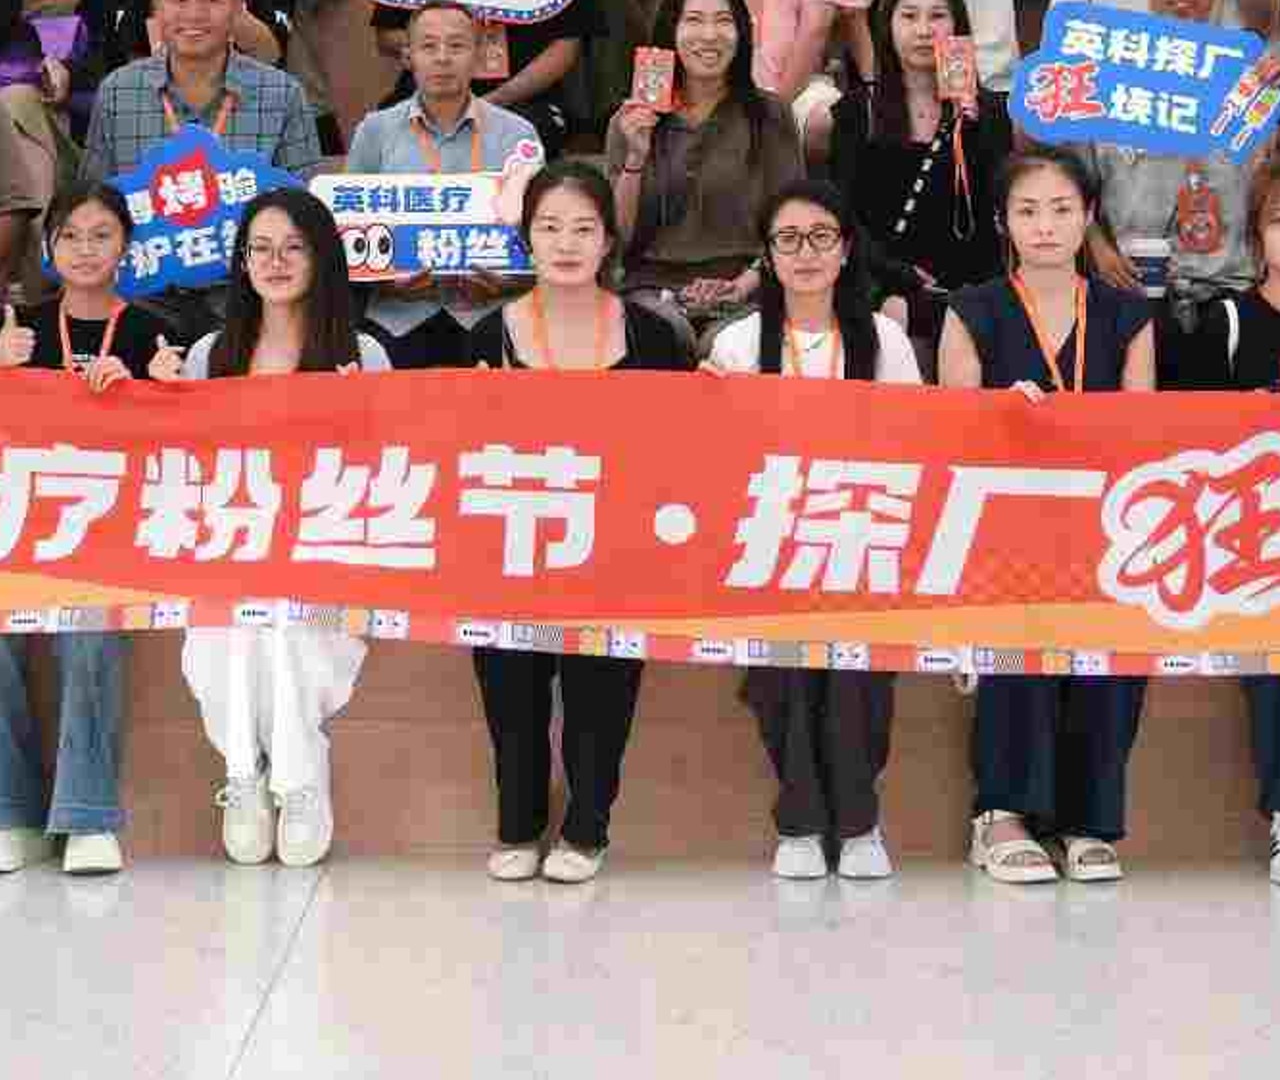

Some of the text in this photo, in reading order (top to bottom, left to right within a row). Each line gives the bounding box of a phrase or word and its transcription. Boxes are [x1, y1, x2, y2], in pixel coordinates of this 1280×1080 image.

[1061, 19, 1244, 79] 英科探厂
[332, 185, 473, 214] 英科医疗
